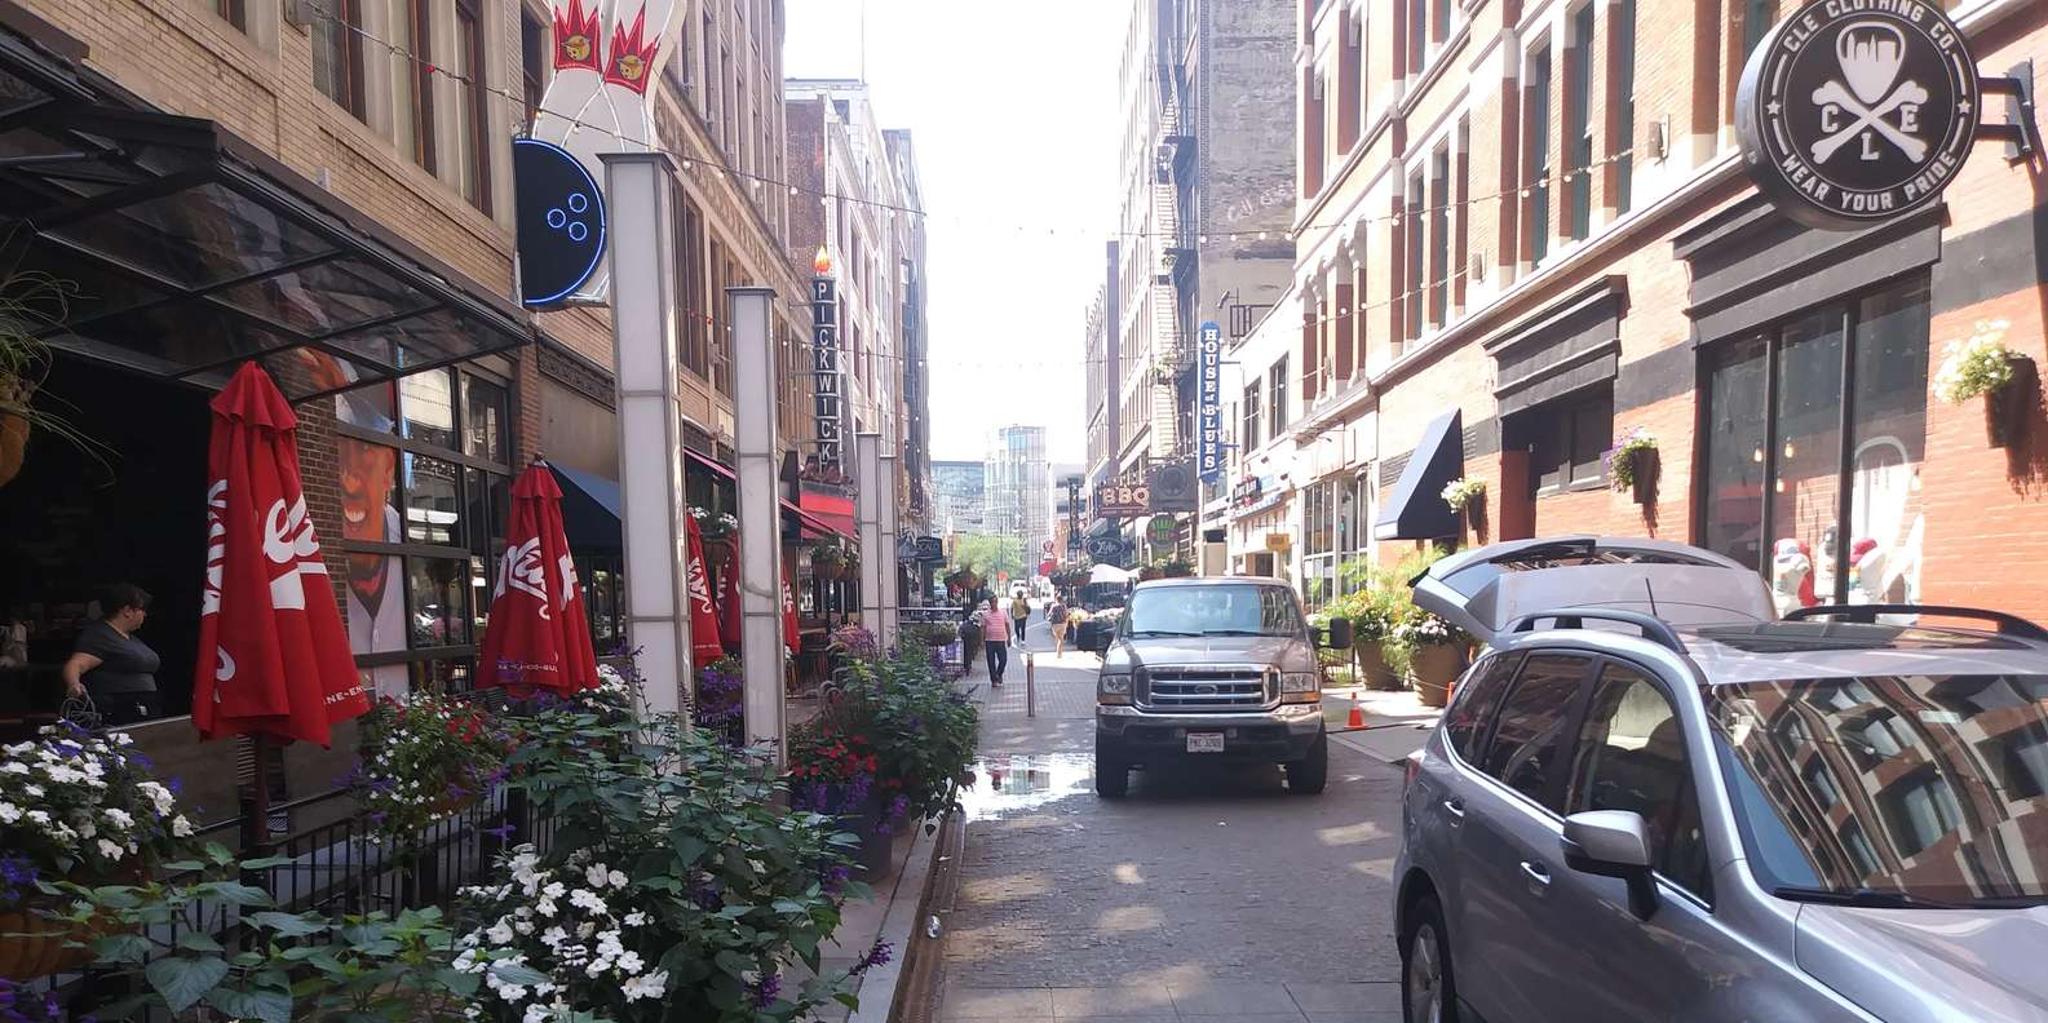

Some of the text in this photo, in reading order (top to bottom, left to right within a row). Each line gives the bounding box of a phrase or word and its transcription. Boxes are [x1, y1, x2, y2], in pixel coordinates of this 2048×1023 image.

[1783, 12, 1820, 53] CLE
[1825, 0, 1925, 23] CLOTHING
[1781, 151, 1957, 212] WEAR YOUR PRIDE
[818, 282, 832, 460] PICKWICK
[1204, 329, 1218, 393] HOUSE
[1204, 404, 1217, 468] BLUES
[1102, 486, 1150, 507] BBQ
